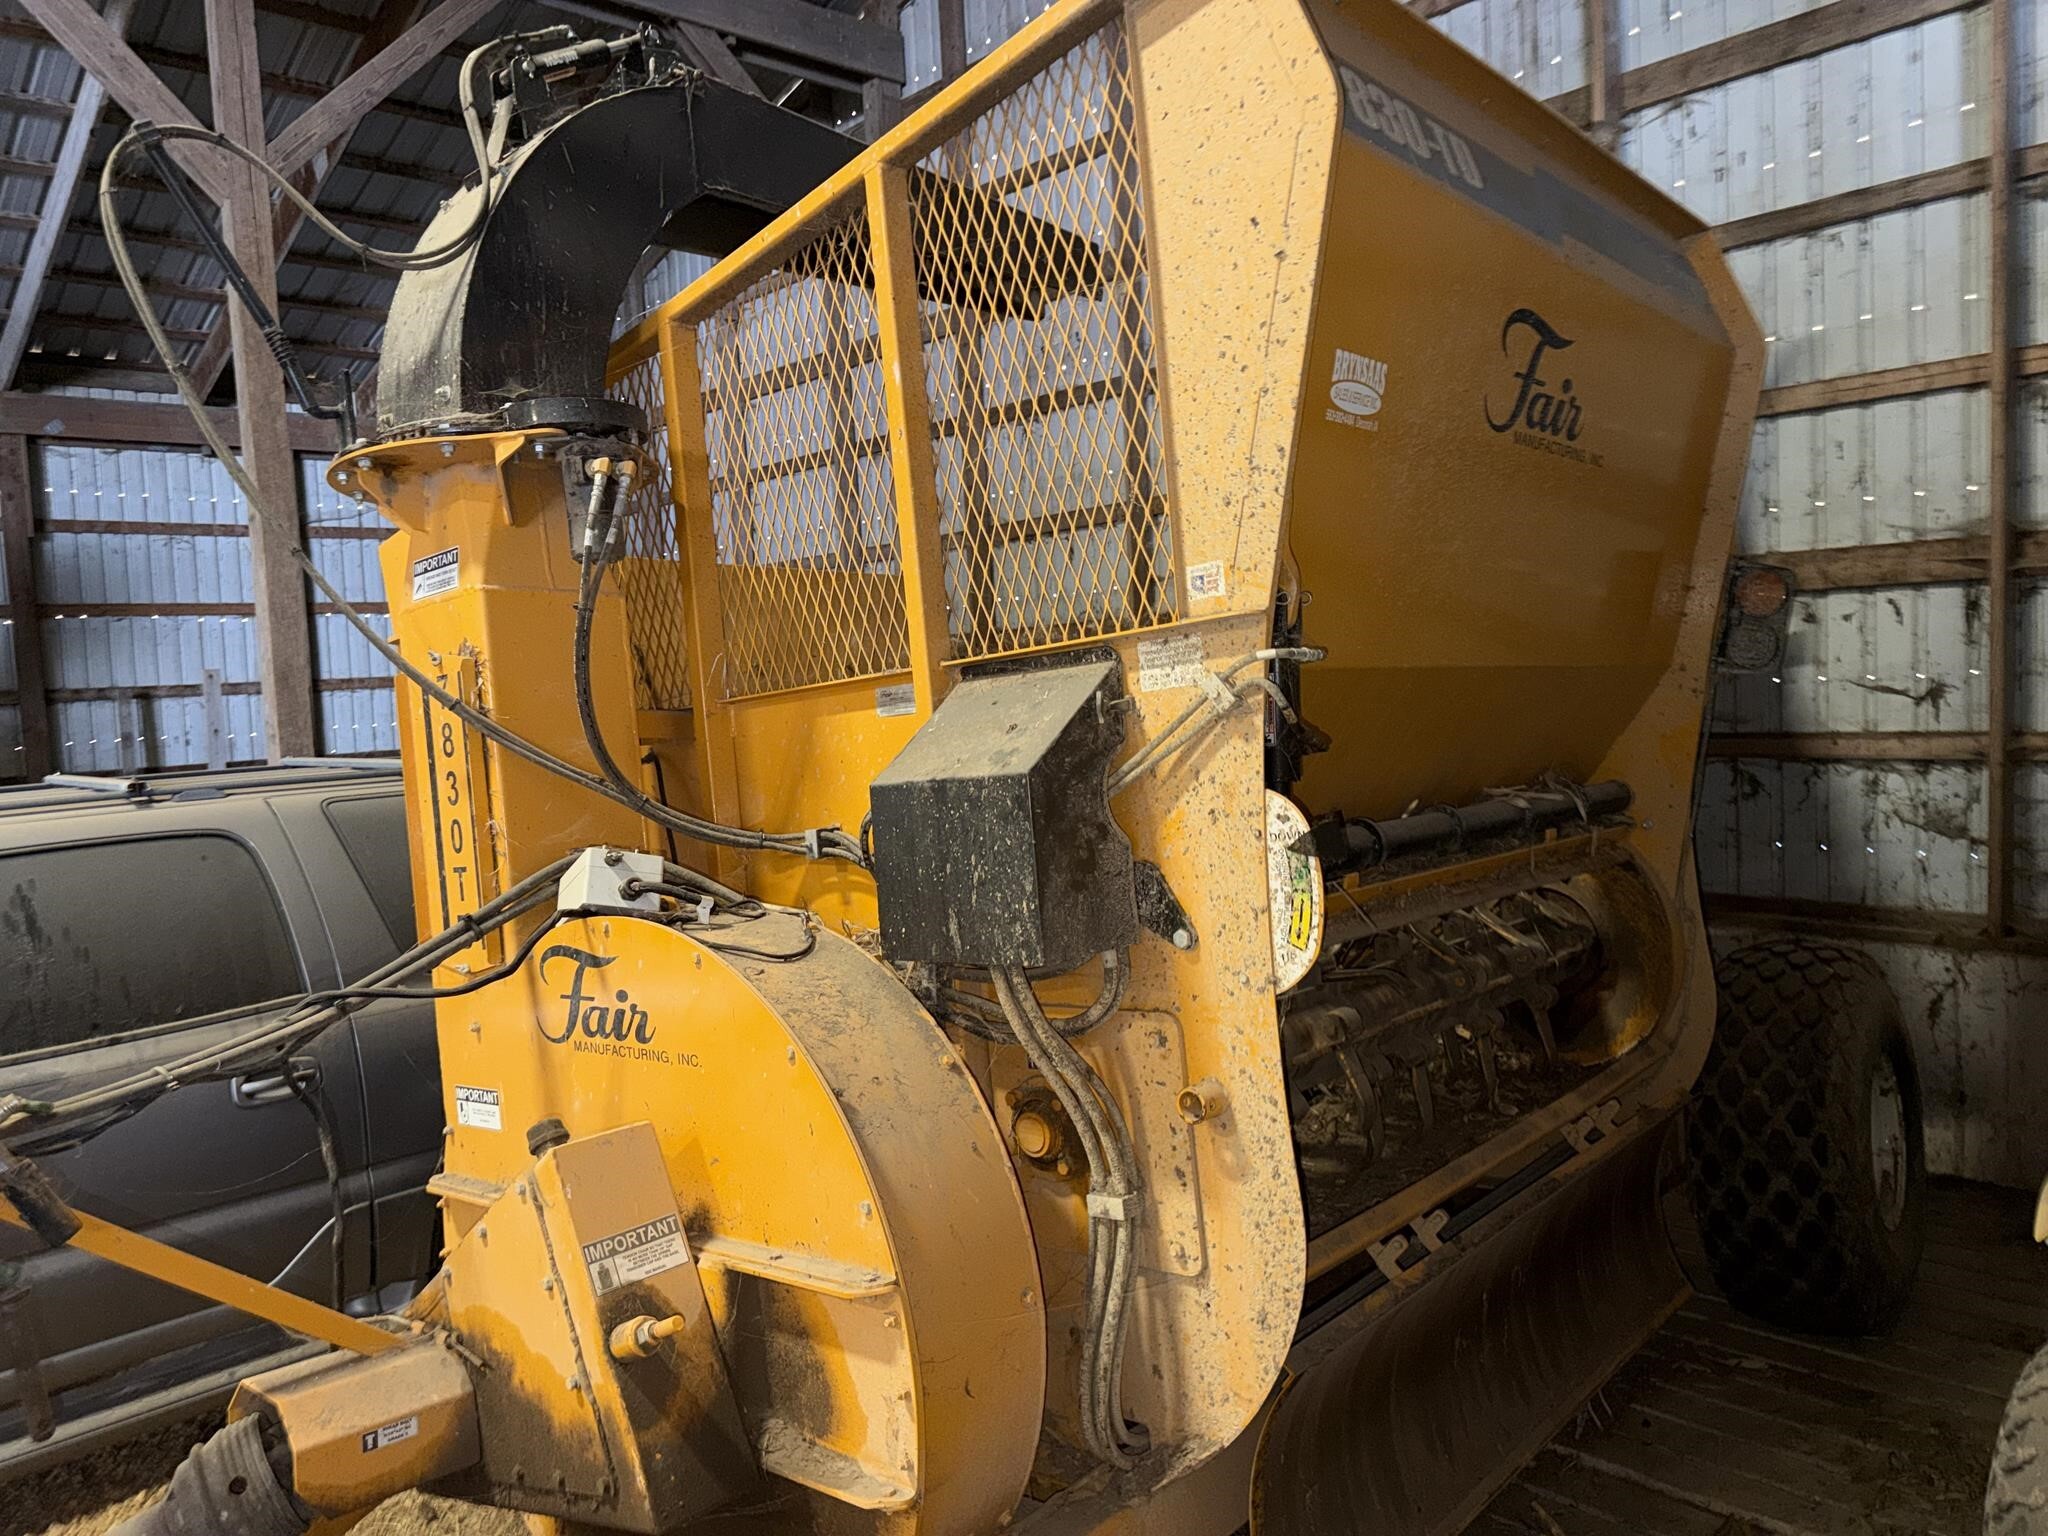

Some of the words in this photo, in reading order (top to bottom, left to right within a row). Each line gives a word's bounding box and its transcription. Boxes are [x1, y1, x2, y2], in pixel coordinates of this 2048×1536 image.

[1331, 348, 1388, 396] BRYNSAAS
[1484, 308, 1585, 441] Fair
[414, 550, 458, 576] IMPORTANT
[437, 674, 469, 918] 7830T
[536, 945, 656, 1045] Fair
[574, 1041, 673, 1066] MANUFACTURING,
[678, 1054, 702, 1068] INC.
[455, 1087, 498, 1105] IMPORTANT
[584, 1216, 678, 1263] IMPORTANT
